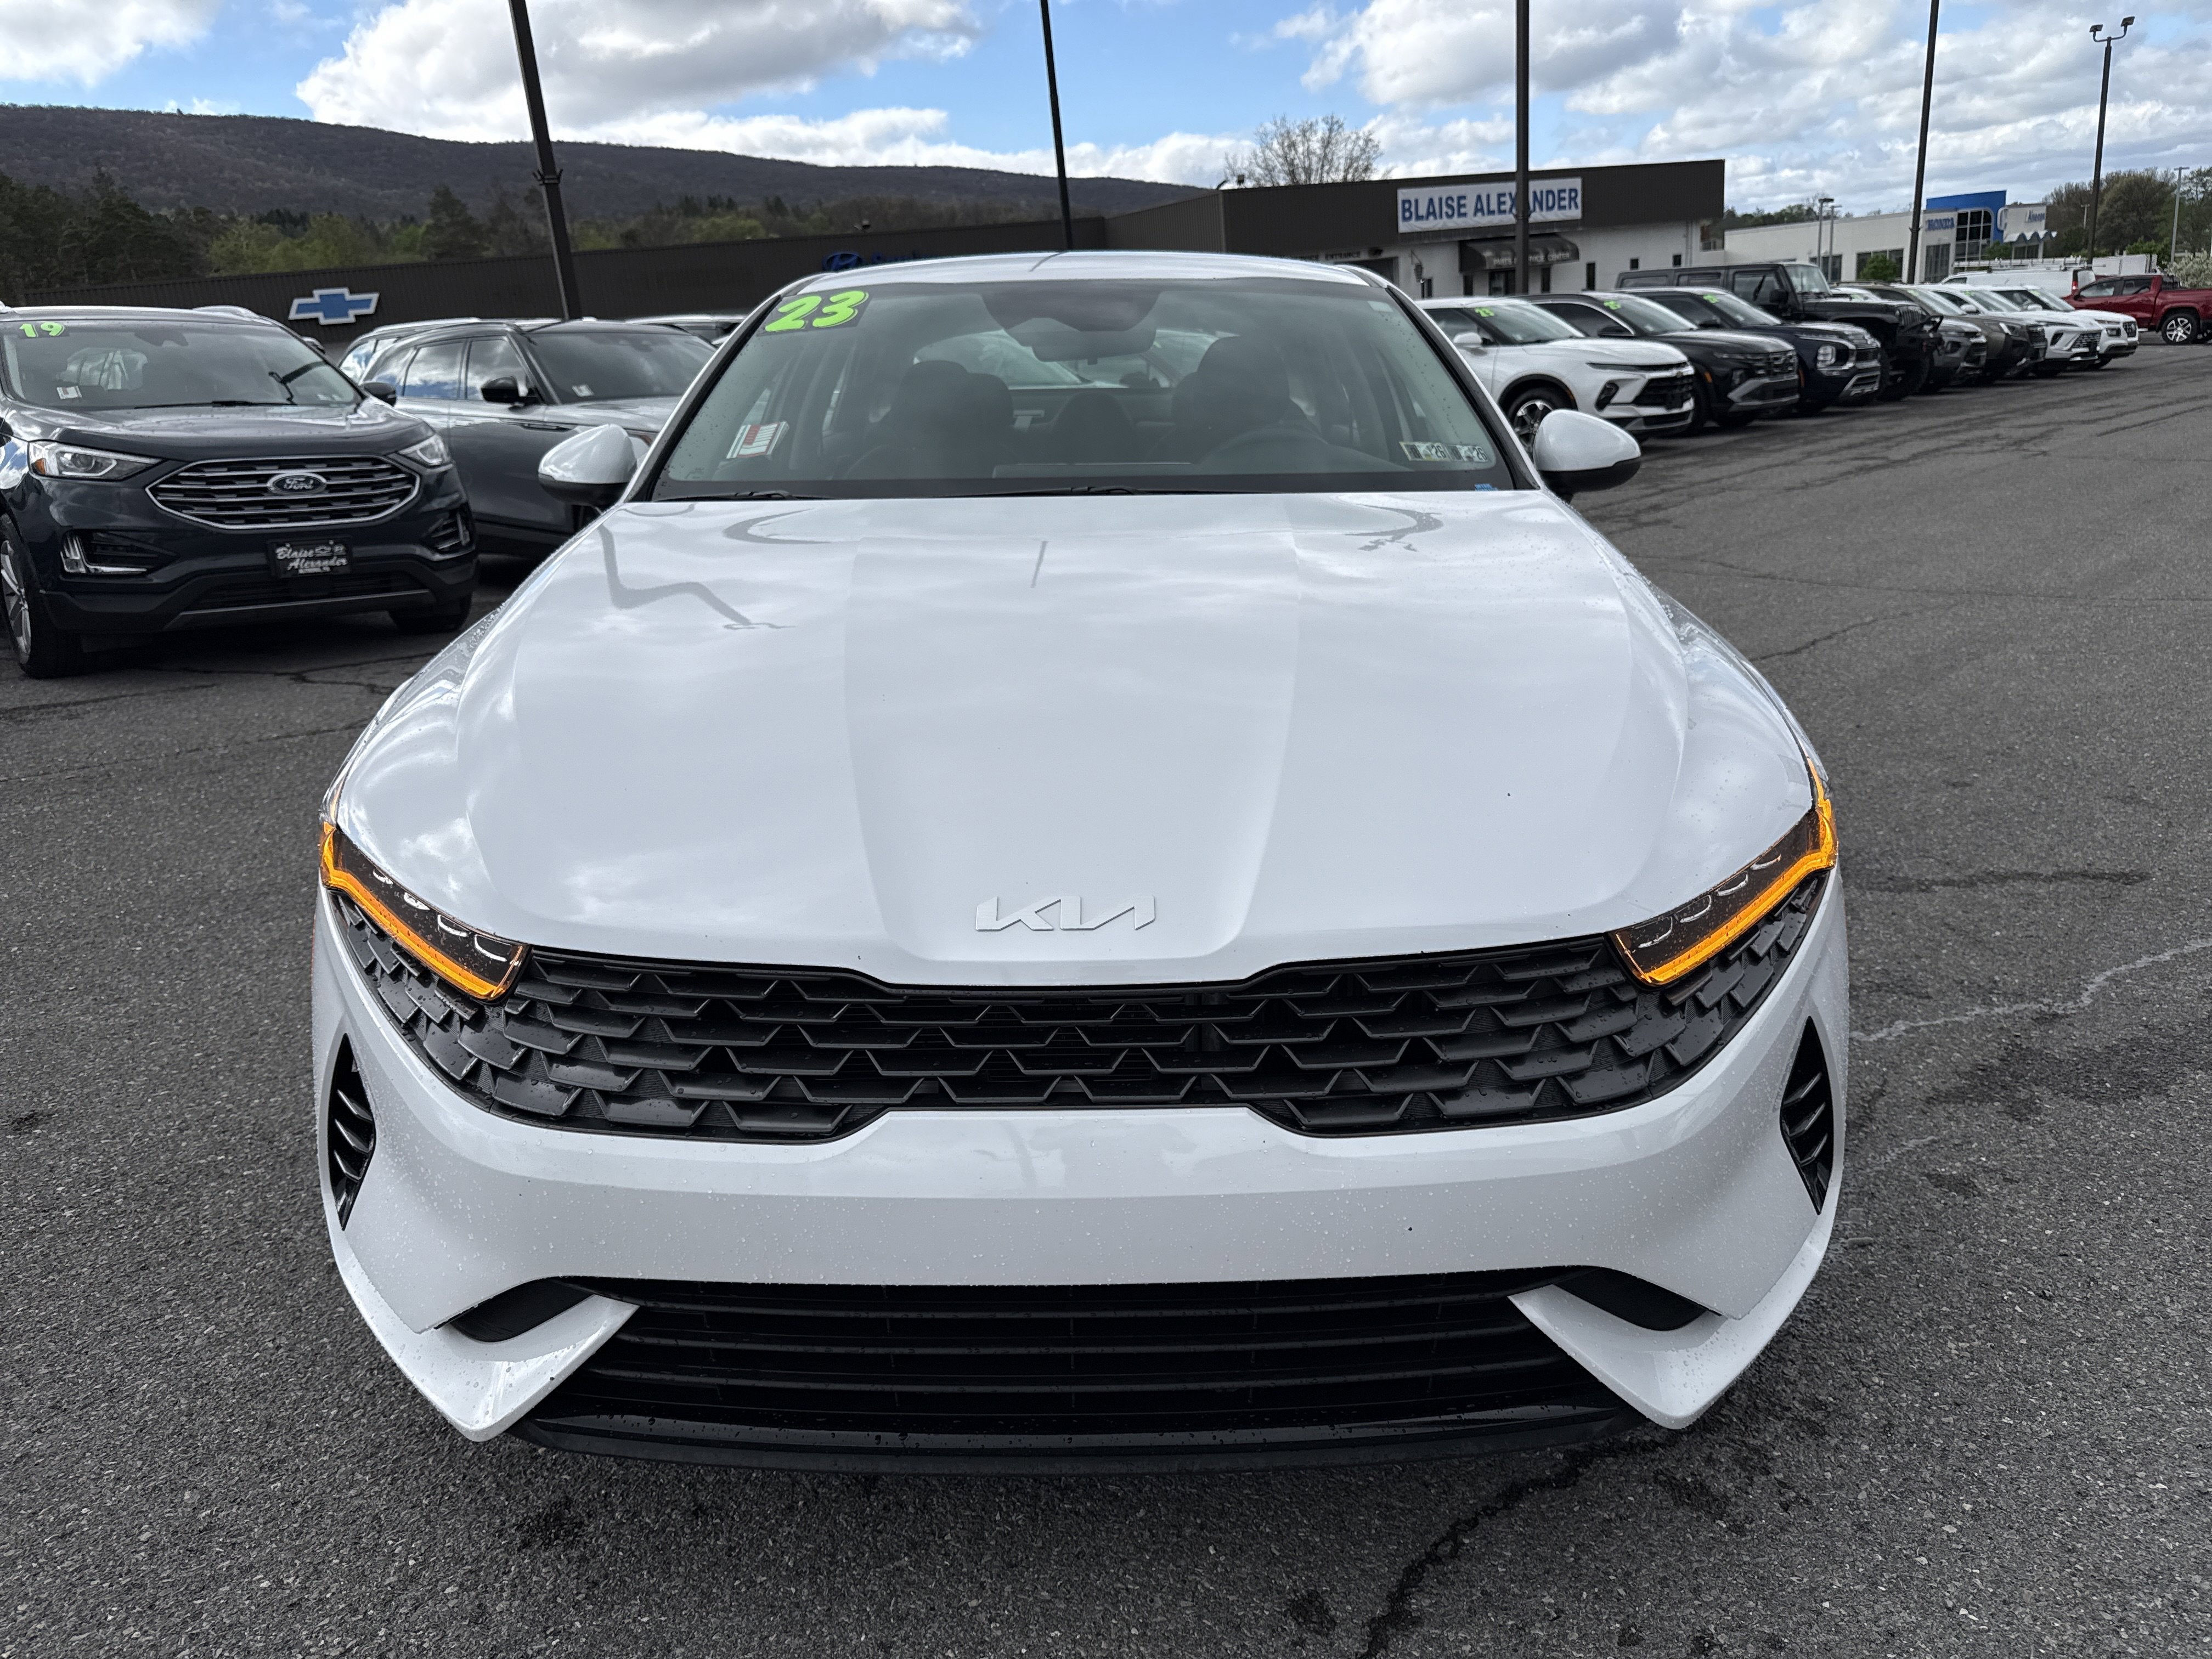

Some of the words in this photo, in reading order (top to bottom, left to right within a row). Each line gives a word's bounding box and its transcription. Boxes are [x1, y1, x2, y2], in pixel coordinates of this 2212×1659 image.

[1401, 195, 1468, 223] BLAISE
[1473, 188, 1579, 217] ALEXNDER
[765, 290, 870, 332] 23
[19, 321, 65, 338] 19
[1432, 444, 1447, 459] 26
[1472, 447, 1488, 461] 26
[283, 477, 314, 490] Ford
[276, 546, 315, 560] Blaise
[287, 555, 348, 571] Alexander
